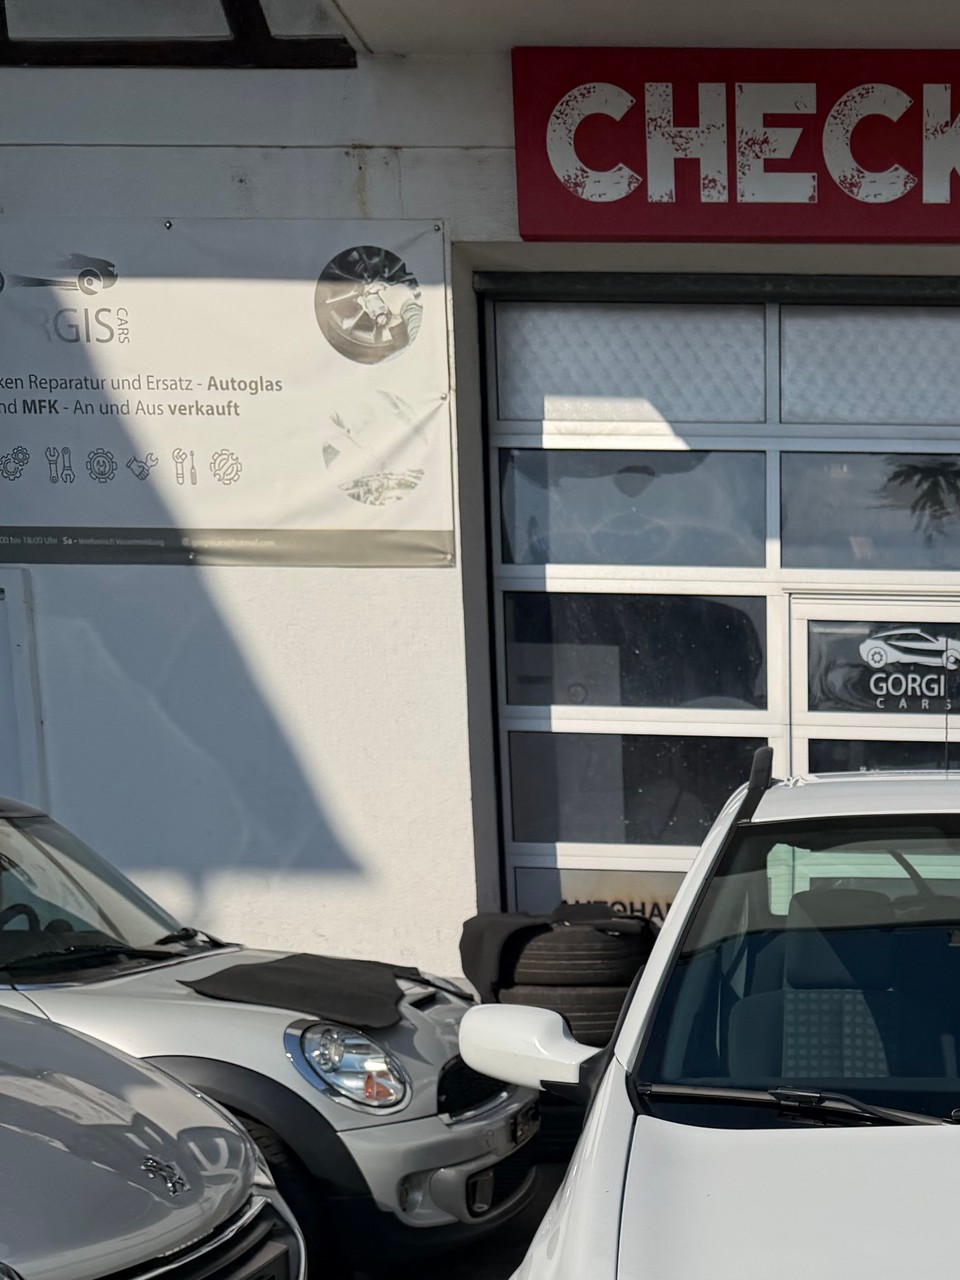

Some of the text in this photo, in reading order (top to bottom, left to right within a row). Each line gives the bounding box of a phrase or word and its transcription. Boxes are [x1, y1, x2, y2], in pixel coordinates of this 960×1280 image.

[116, 307, 130, 344] CARS
[29, 374, 106, 393] Reparatur
[111, 375, 142, 391] und
[146, 375, 193, 392] Ersatz
[207, 376, 283, 395] Autoglas
[23, 400, 59, 414] MFK
[73, 400, 95, 415] An
[100, 400, 130, 415] und
[135, 400, 164, 416] Aus
[168, 401, 241, 417] verkauft
[869, 672, 945, 697] GORGI
